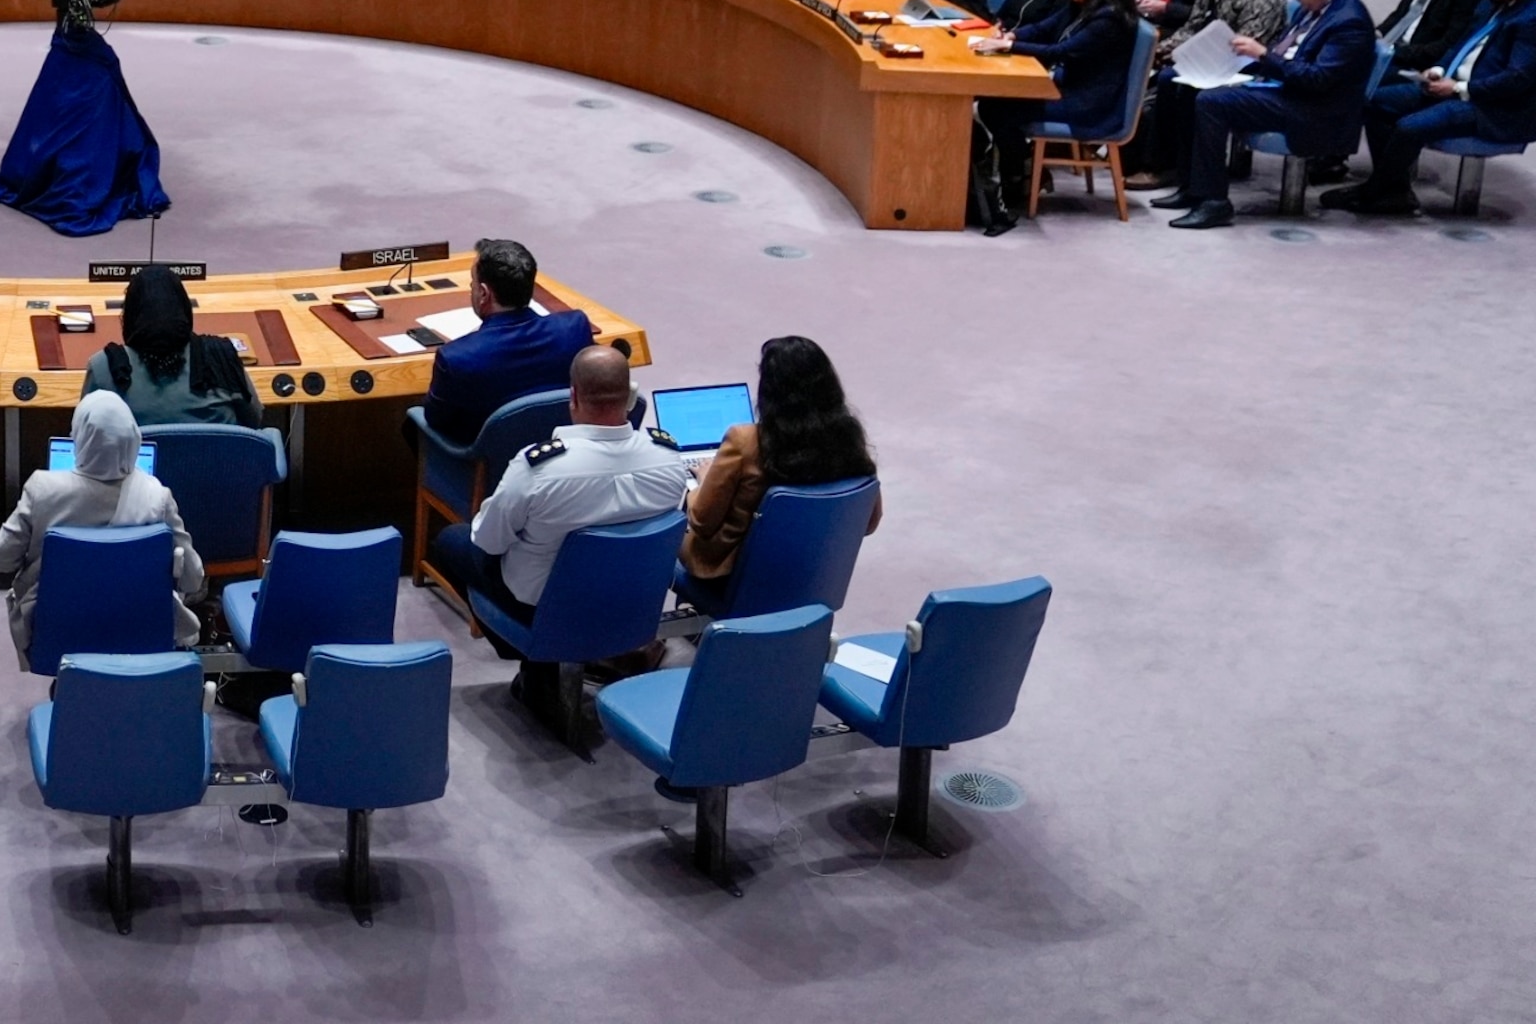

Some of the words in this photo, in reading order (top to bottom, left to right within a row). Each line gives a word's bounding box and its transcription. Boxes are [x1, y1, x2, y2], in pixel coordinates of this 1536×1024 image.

[372, 248, 419, 265] ISRAEL
[93, 266, 126, 276] UNITED
[169, 266, 202, 276] RATES
